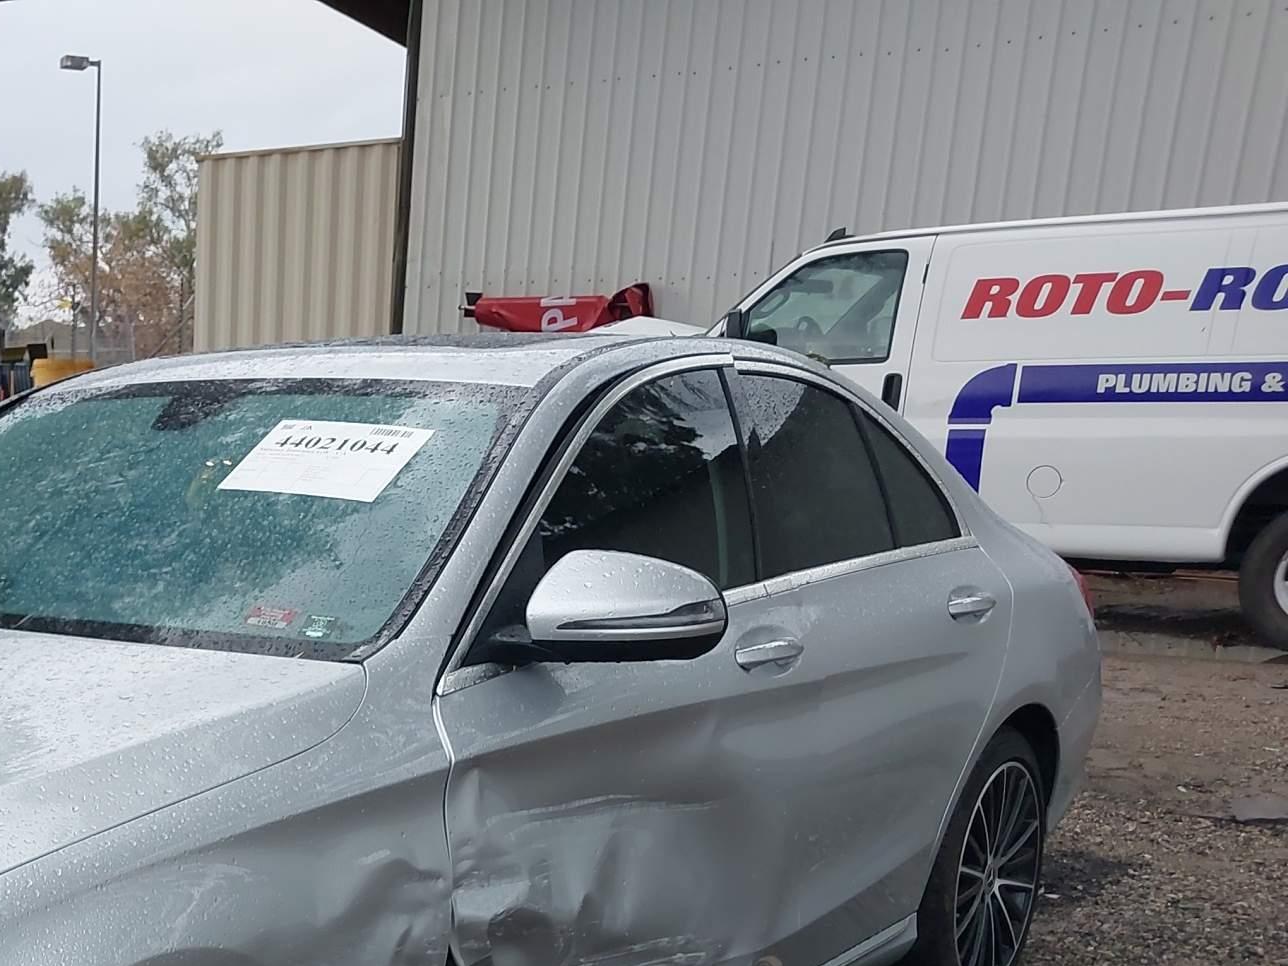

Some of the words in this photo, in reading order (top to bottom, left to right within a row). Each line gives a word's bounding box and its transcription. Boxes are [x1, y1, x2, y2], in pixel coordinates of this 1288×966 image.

[1096, 371, 1253, 394] PLUMBING
[1260, 372, 1286, 393] &
[275, 435, 399, 455] 44021044
